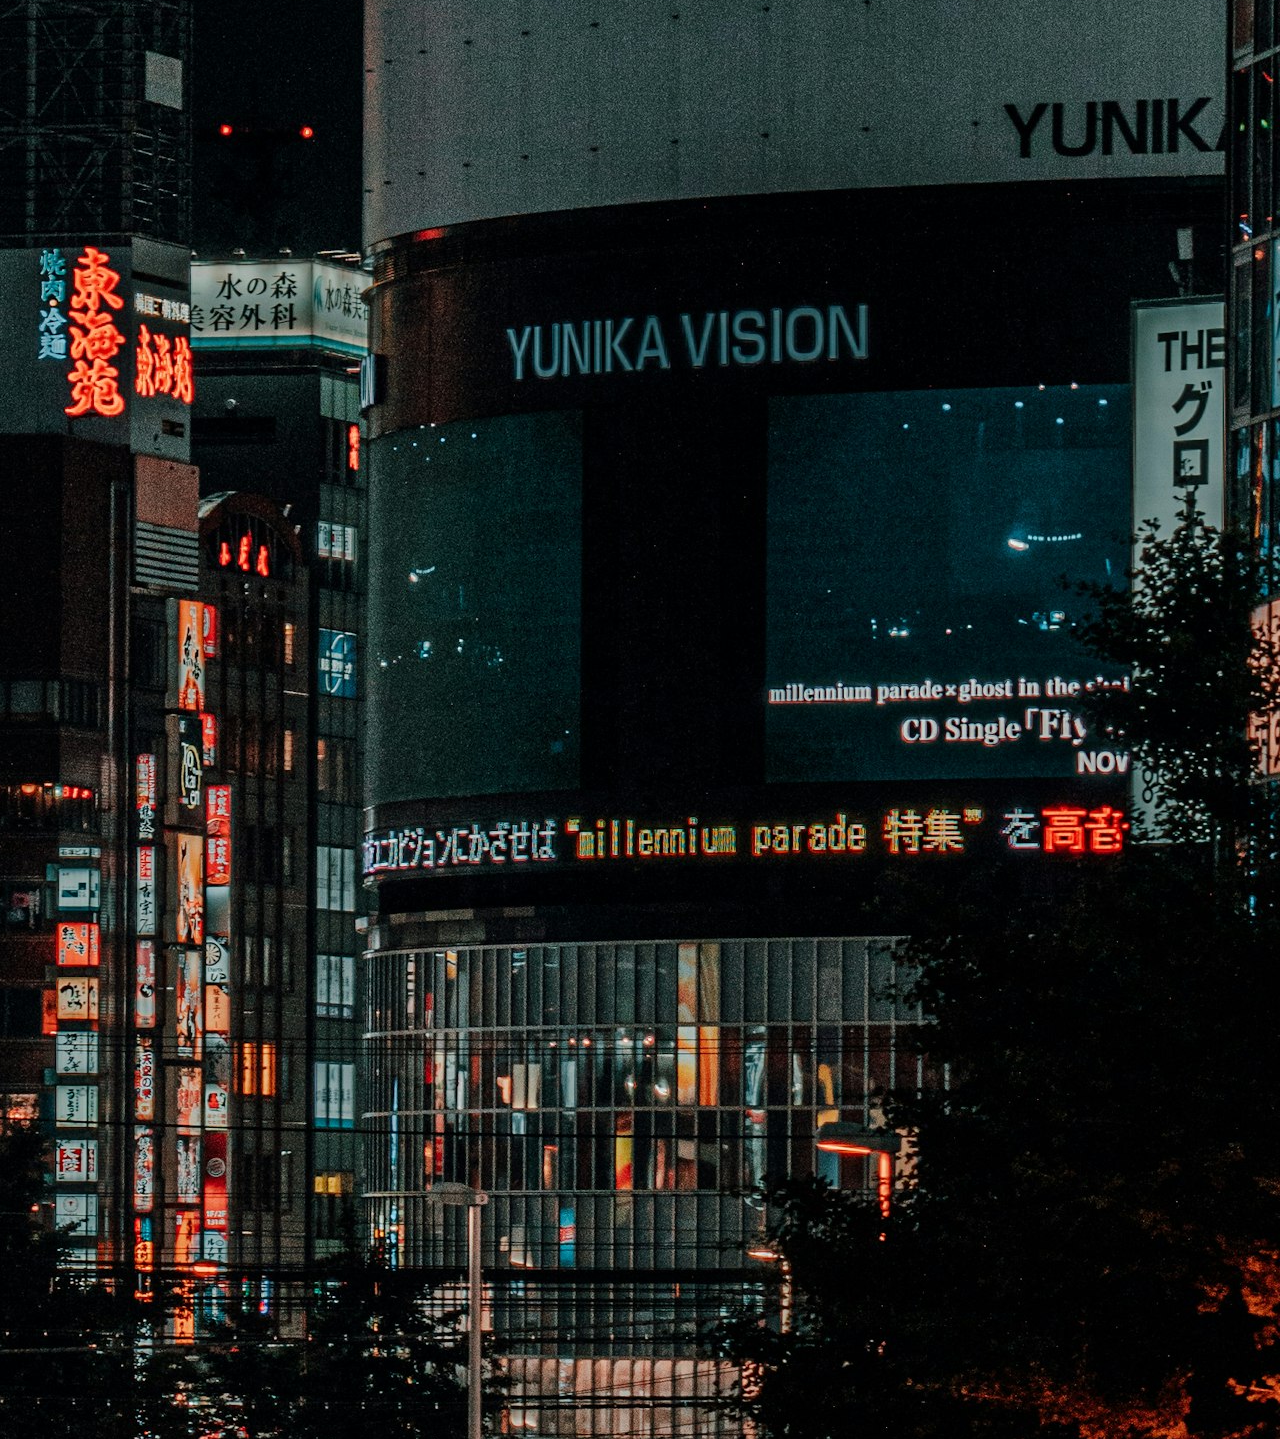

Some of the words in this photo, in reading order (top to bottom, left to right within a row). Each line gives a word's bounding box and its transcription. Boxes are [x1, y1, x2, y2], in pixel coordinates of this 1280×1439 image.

[215, 270, 299, 301] 水の森
[65, 246, 127, 418] 東海苑
[507, 316, 671, 380] YUNIKA
[682, 304, 870, 370] VISION
[769, 681, 872, 704] millennium
[1018, 676, 1040, 698] in
[1045, 675, 1081, 697] the
[900, 717, 939, 742] CD
[944, 715, 1022, 746] Single
[751, 812, 867, 855] parade
